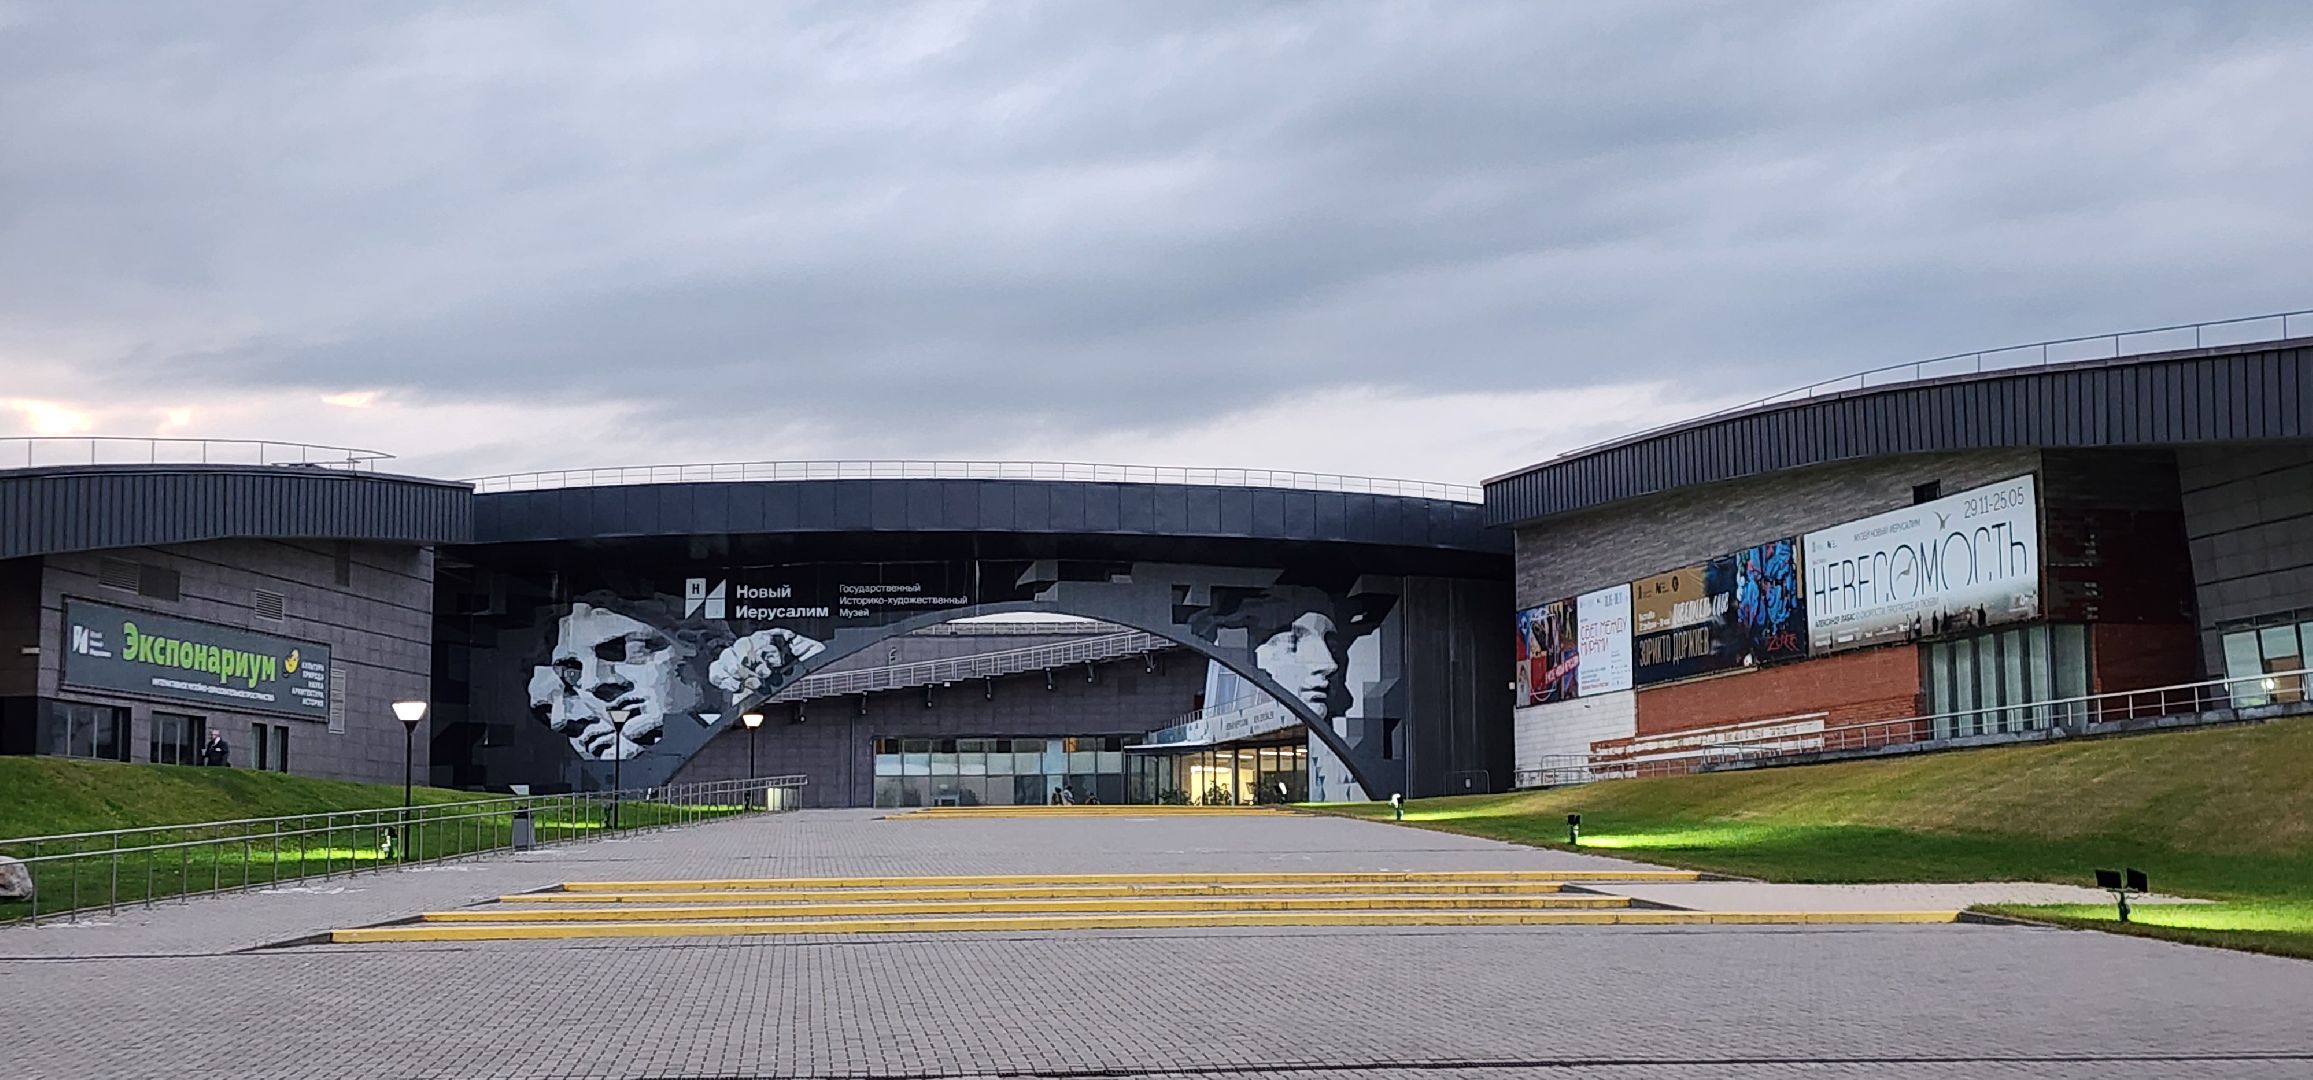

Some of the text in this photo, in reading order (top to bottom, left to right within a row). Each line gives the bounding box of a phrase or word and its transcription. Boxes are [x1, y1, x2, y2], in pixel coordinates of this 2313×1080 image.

[1812, 520, 2028, 617] НЕВЕСОМОСТЬ
[736, 584, 792, 599] Новый
[839, 583, 921, 595] Государственный
[839, 595, 968, 607] Историко-художественный
[735, 605, 829, 621] Иерусалим
[839, 607, 870, 619] Музей
[122, 621, 277, 688] Экспонариум
[1639, 634, 1671, 668] ЗОРИКТО
[1672, 627, 1710, 666] ДОРЖИЕВ
